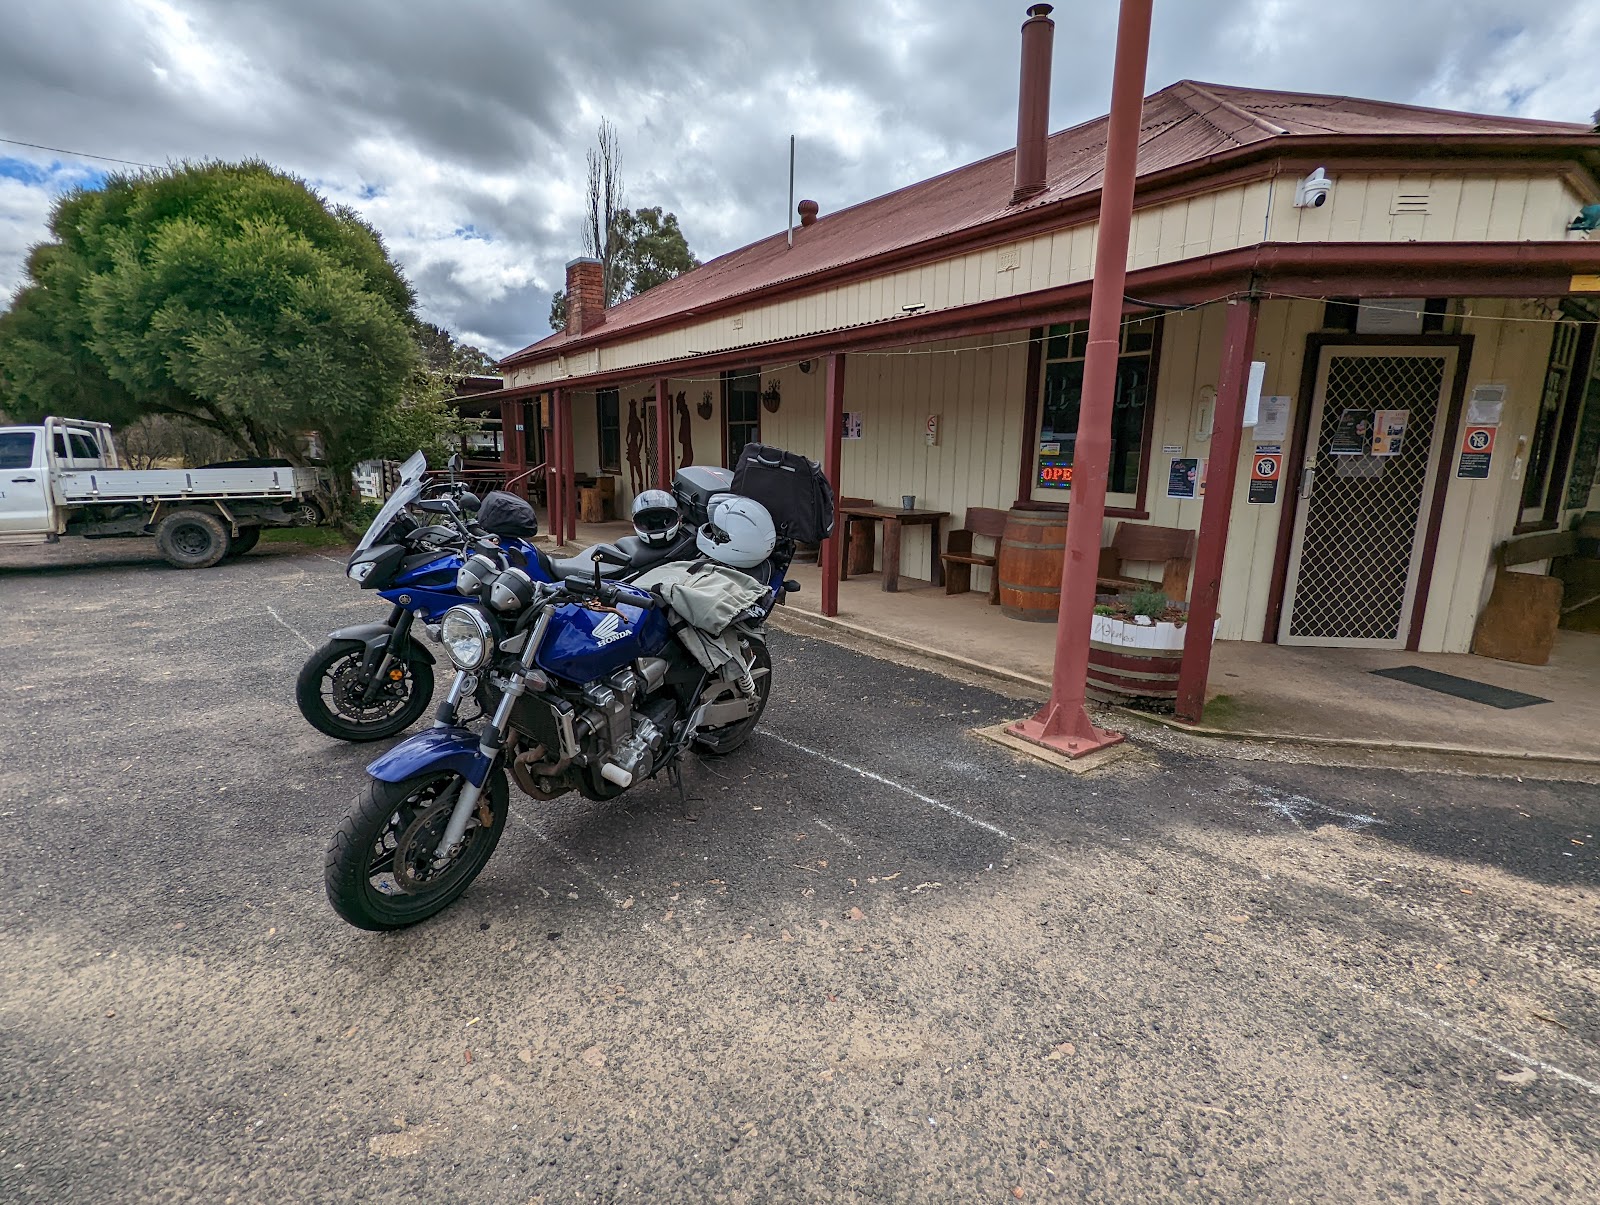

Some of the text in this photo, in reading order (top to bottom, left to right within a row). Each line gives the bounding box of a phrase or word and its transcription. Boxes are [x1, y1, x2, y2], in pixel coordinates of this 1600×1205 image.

[1047, 370, 1144, 411] BR
[1043, 467, 1073, 481] OPE
[596, 629, 633, 648] HONDA
